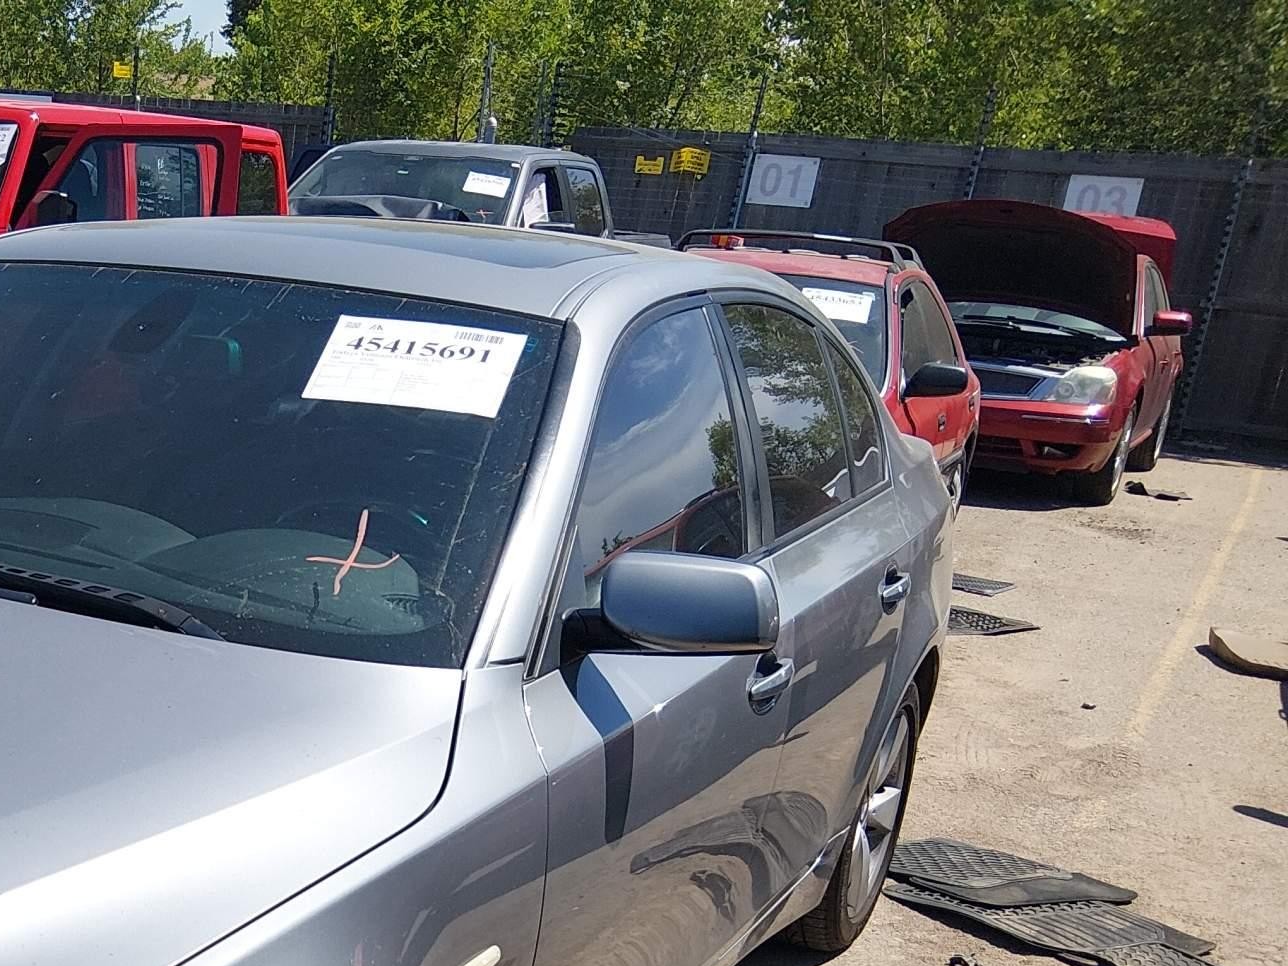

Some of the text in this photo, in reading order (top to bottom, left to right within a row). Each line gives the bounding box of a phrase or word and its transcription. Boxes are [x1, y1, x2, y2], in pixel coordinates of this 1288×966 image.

[759, 162, 803, 198] 01
[1075, 184, 1128, 215] 03
[347, 335, 492, 363] 45415691
